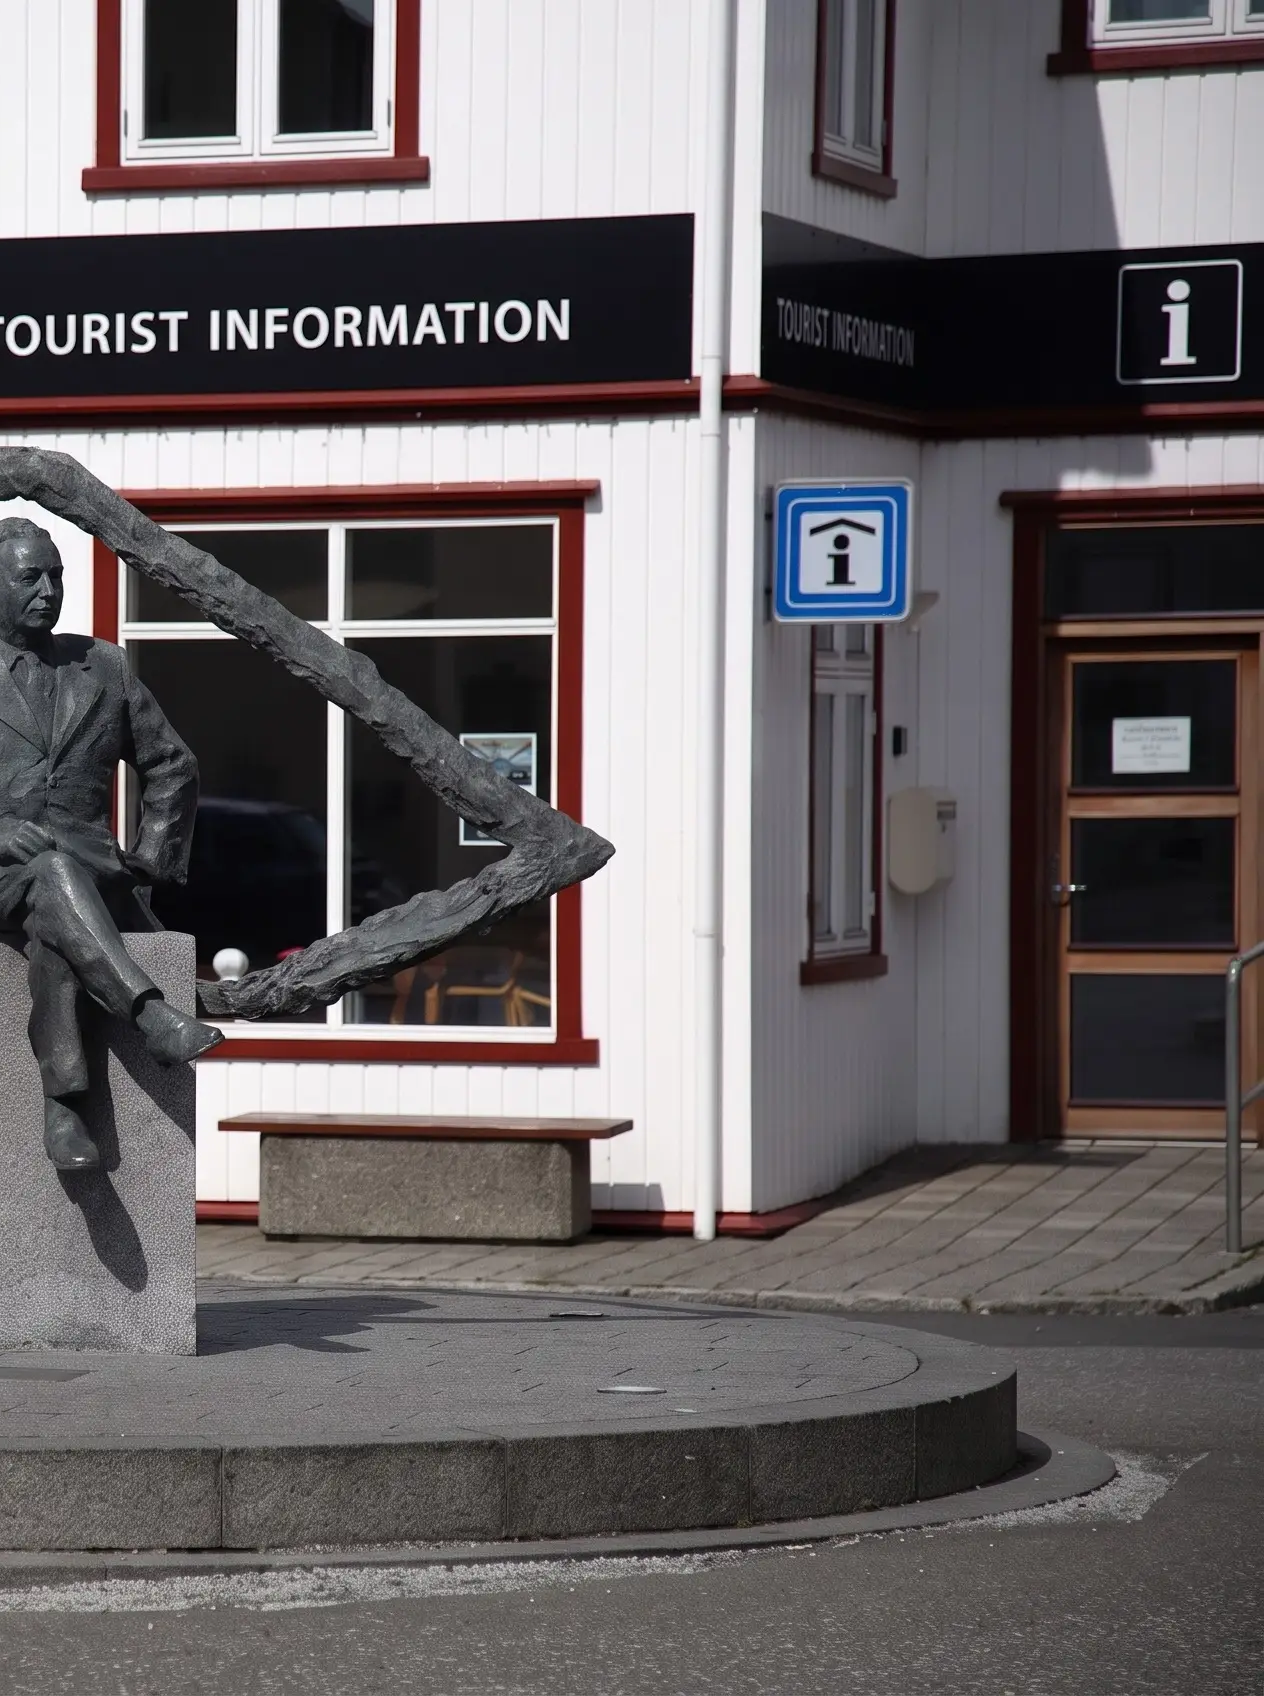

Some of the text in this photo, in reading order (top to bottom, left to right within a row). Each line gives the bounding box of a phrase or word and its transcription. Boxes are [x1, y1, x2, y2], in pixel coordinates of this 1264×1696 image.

[209, 298, 571, 351] INFORMATION
[777, 297, 915, 367] TOURIST INFORMATION
